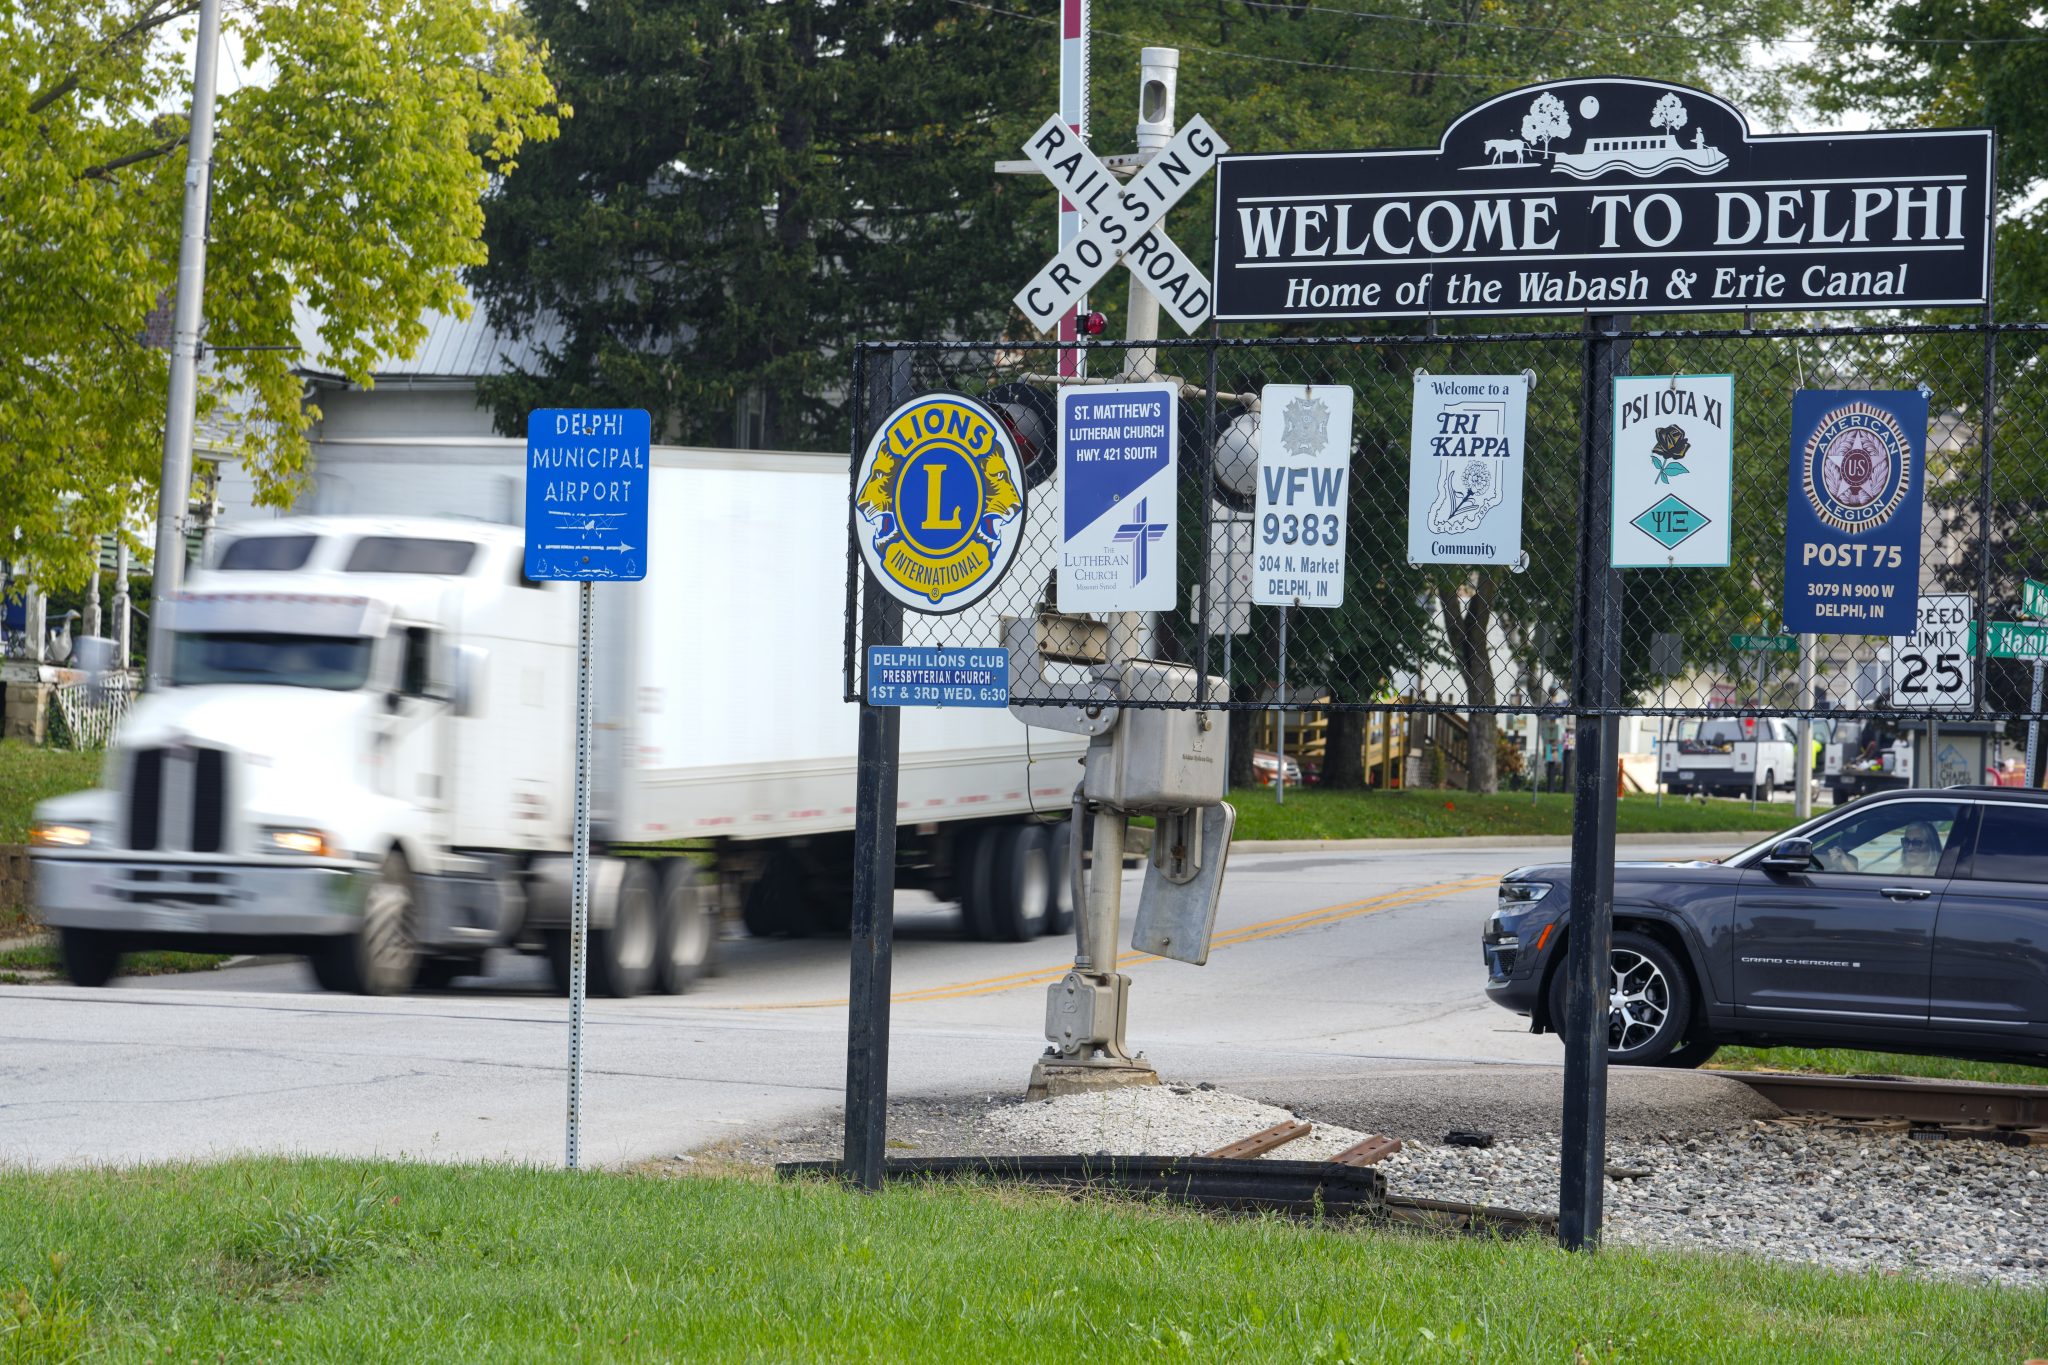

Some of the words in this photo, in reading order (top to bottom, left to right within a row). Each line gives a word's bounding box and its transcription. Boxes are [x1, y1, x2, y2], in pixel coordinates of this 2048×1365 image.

[1027, 128, 1214, 316] CROSSING
[1237, 197, 1560, 258] WELCOME
[1591, 193, 1683, 248] TO
[1713, 185, 1966, 245] DELPHI
[1284, 278, 1381, 307] Home
[1395, 273, 1433, 305] of
[1446, 273, 1502, 303] the
[1519, 270, 1648, 303] Wabash
[1665, 268, 1697, 299] &
[1712, 265, 1785, 298] Erie
[1801, 264, 1908, 296] Canal
[1431, 381, 1486, 396] Welcome
[1488, 384, 1500, 395] to
[1502, 387, 1509, 395] a
[1074, 406, 1090, 421] ST.
[1094, 403, 1161, 419] MATTHEW'S
[1622, 394, 1648, 430] PSI
[1655, 389, 1697, 417] IOTA
[1703, 395, 1721, 429] XI
[556, 413, 623, 436] DELPHI
[894, 408, 988, 451] LIONS
[1070, 427, 1121, 441] LUTHERAN
[1123, 425, 1165, 439] CHURCH
[1437, 412, 1480, 434] TRI
[1819, 416, 1898, 454] AMERICAN
[533, 446, 643, 469] MUNICIPAL
[1076, 449, 1101, 462] HWY.
[1104, 447, 1121, 461] 421
[1124, 446, 1157, 460] SOUTH
[1430, 437, 1511, 457] KAPPA
[544, 480, 632, 502] AIRPORT
[921, 464, 962, 530] L
[1263, 466, 1344, 507] VFW
[1825, 499, 1885, 520] LEGION
[1262, 513, 1339, 546] 9383
[1064, 553, 1128, 567] LUTHERAN
[1431, 541, 1497, 558] Community
[1803, 543, 1866, 567] POST
[1873, 546, 1902, 568] 75
[891, 550, 983, 585] INTERNATIONAL
[1075, 568, 1118, 580] CHURCH
[1259, 555, 1281, 572] 304
[1284, 556, 1296, 572] N.
[1301, 557, 1339, 574] Market
[1269, 579, 1312, 600] DELPHI,
[1316, 581, 1328, 596] IN
[1807, 584, 1840, 597] 3079
[1842, 584, 1853, 597] N
[1856, 584, 1880, 597] 900
[1881, 585, 1895, 598] W
[1815, 604, 1866, 619] DELPHI,
[1870, 605, 1884, 618] IN
[1906, 631, 1957, 647] LIMIT
[873, 654, 921, 666] DELPHI
[926, 655, 965, 667] LIONS
[970, 655, 1004, 668] CLUB
[883, 670, 951, 683] PRESBYTERIAN
[954, 671, 990, 684] CHURCH
[1901, 654, 1963, 693] 25
[871, 686, 895, 698] 1ST
[900, 686, 909, 698] &
[914, 687, 939, 699] 3RD
[944, 688, 976, 700] WED.
[980, 688, 1006, 701] 6:30
[1786, 959, 1849, 967] CHEROKEE
